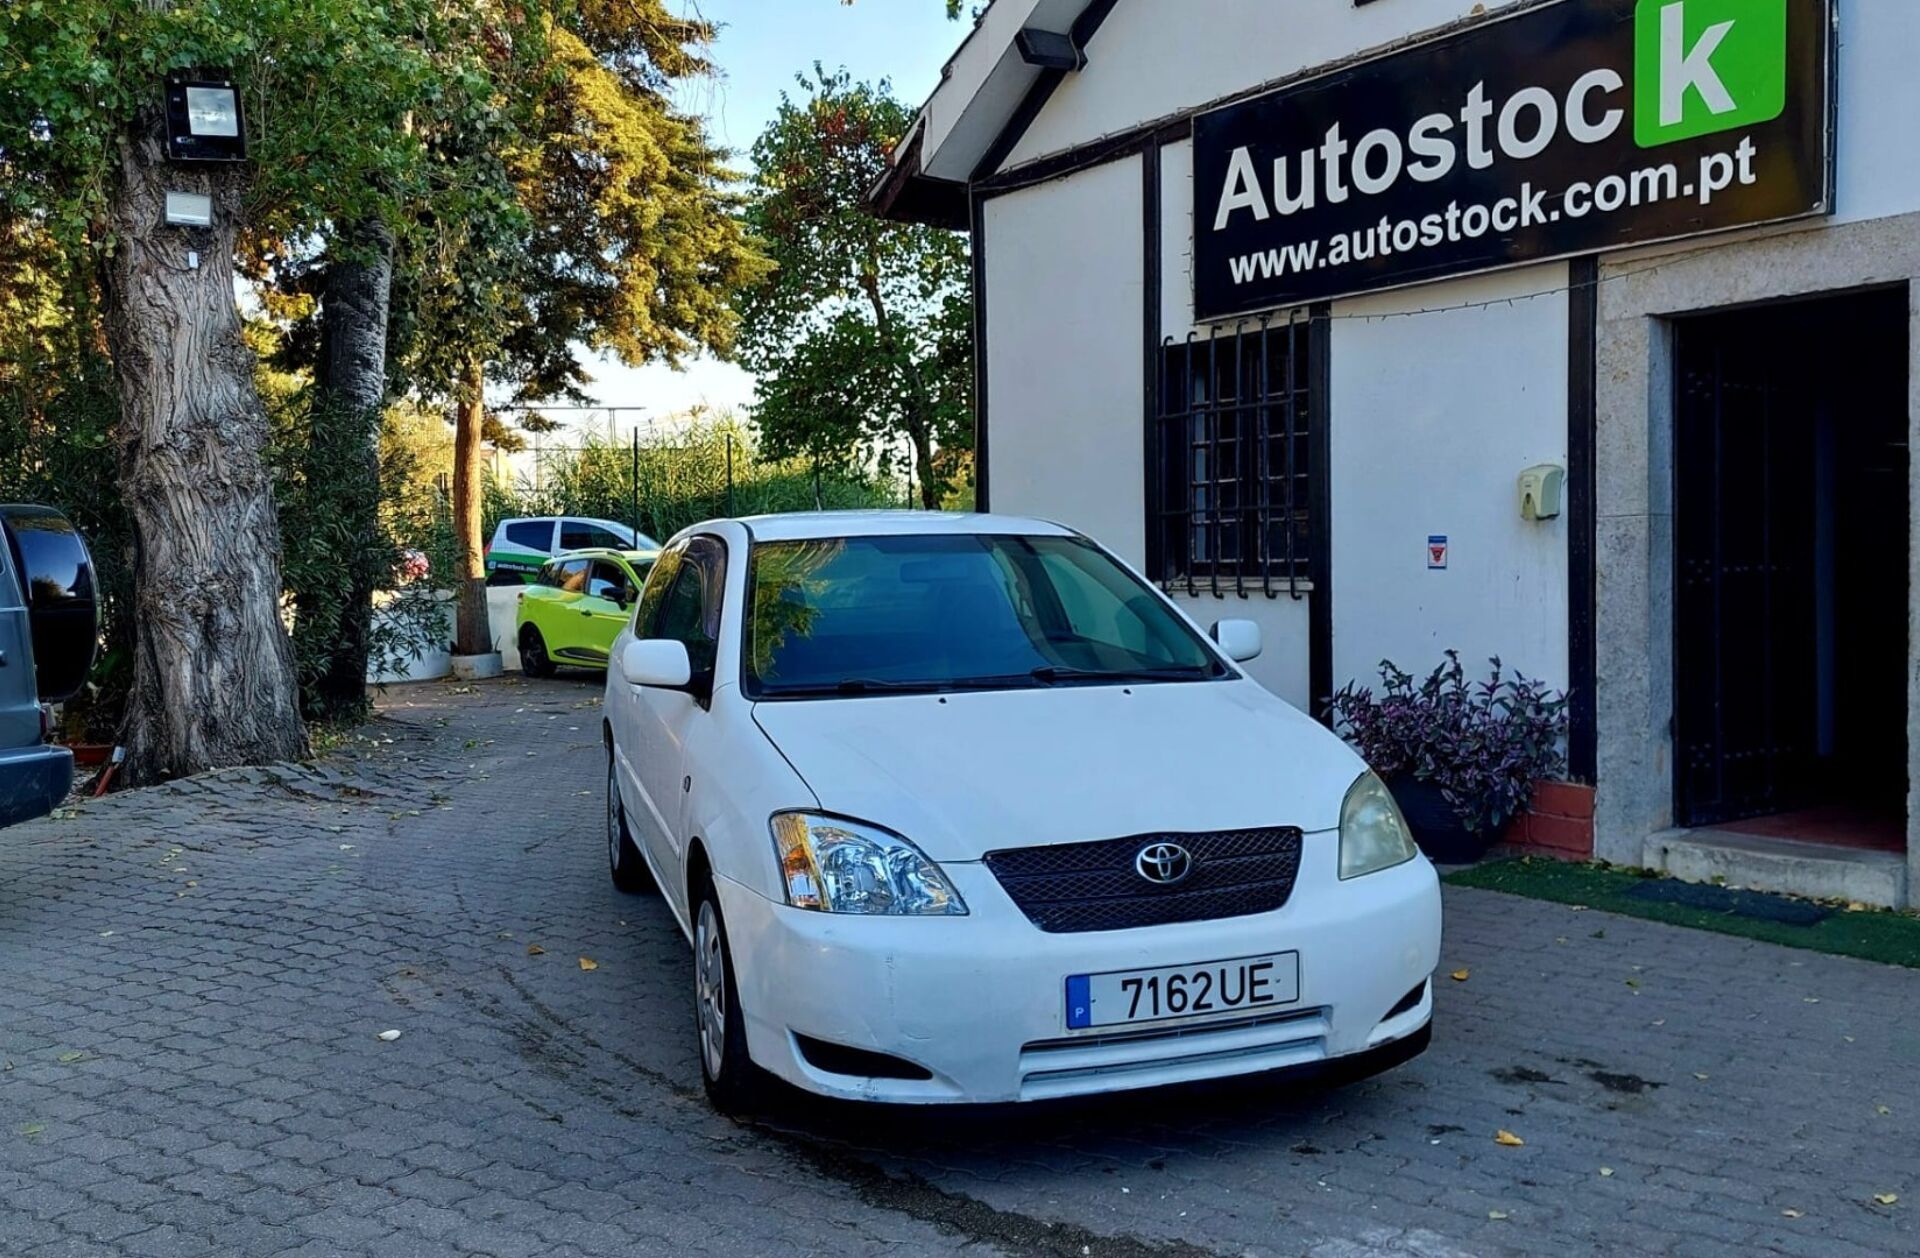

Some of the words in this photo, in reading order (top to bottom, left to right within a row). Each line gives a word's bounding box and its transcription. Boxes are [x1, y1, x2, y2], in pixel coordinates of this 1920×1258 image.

[1213, 0, 1738, 231] Autostock
[1229, 136, 1757, 285] www.autostock.com.pt
[1075, 1007, 1085, 1019] P
[1121, 962, 1274, 1019] 7162UE
